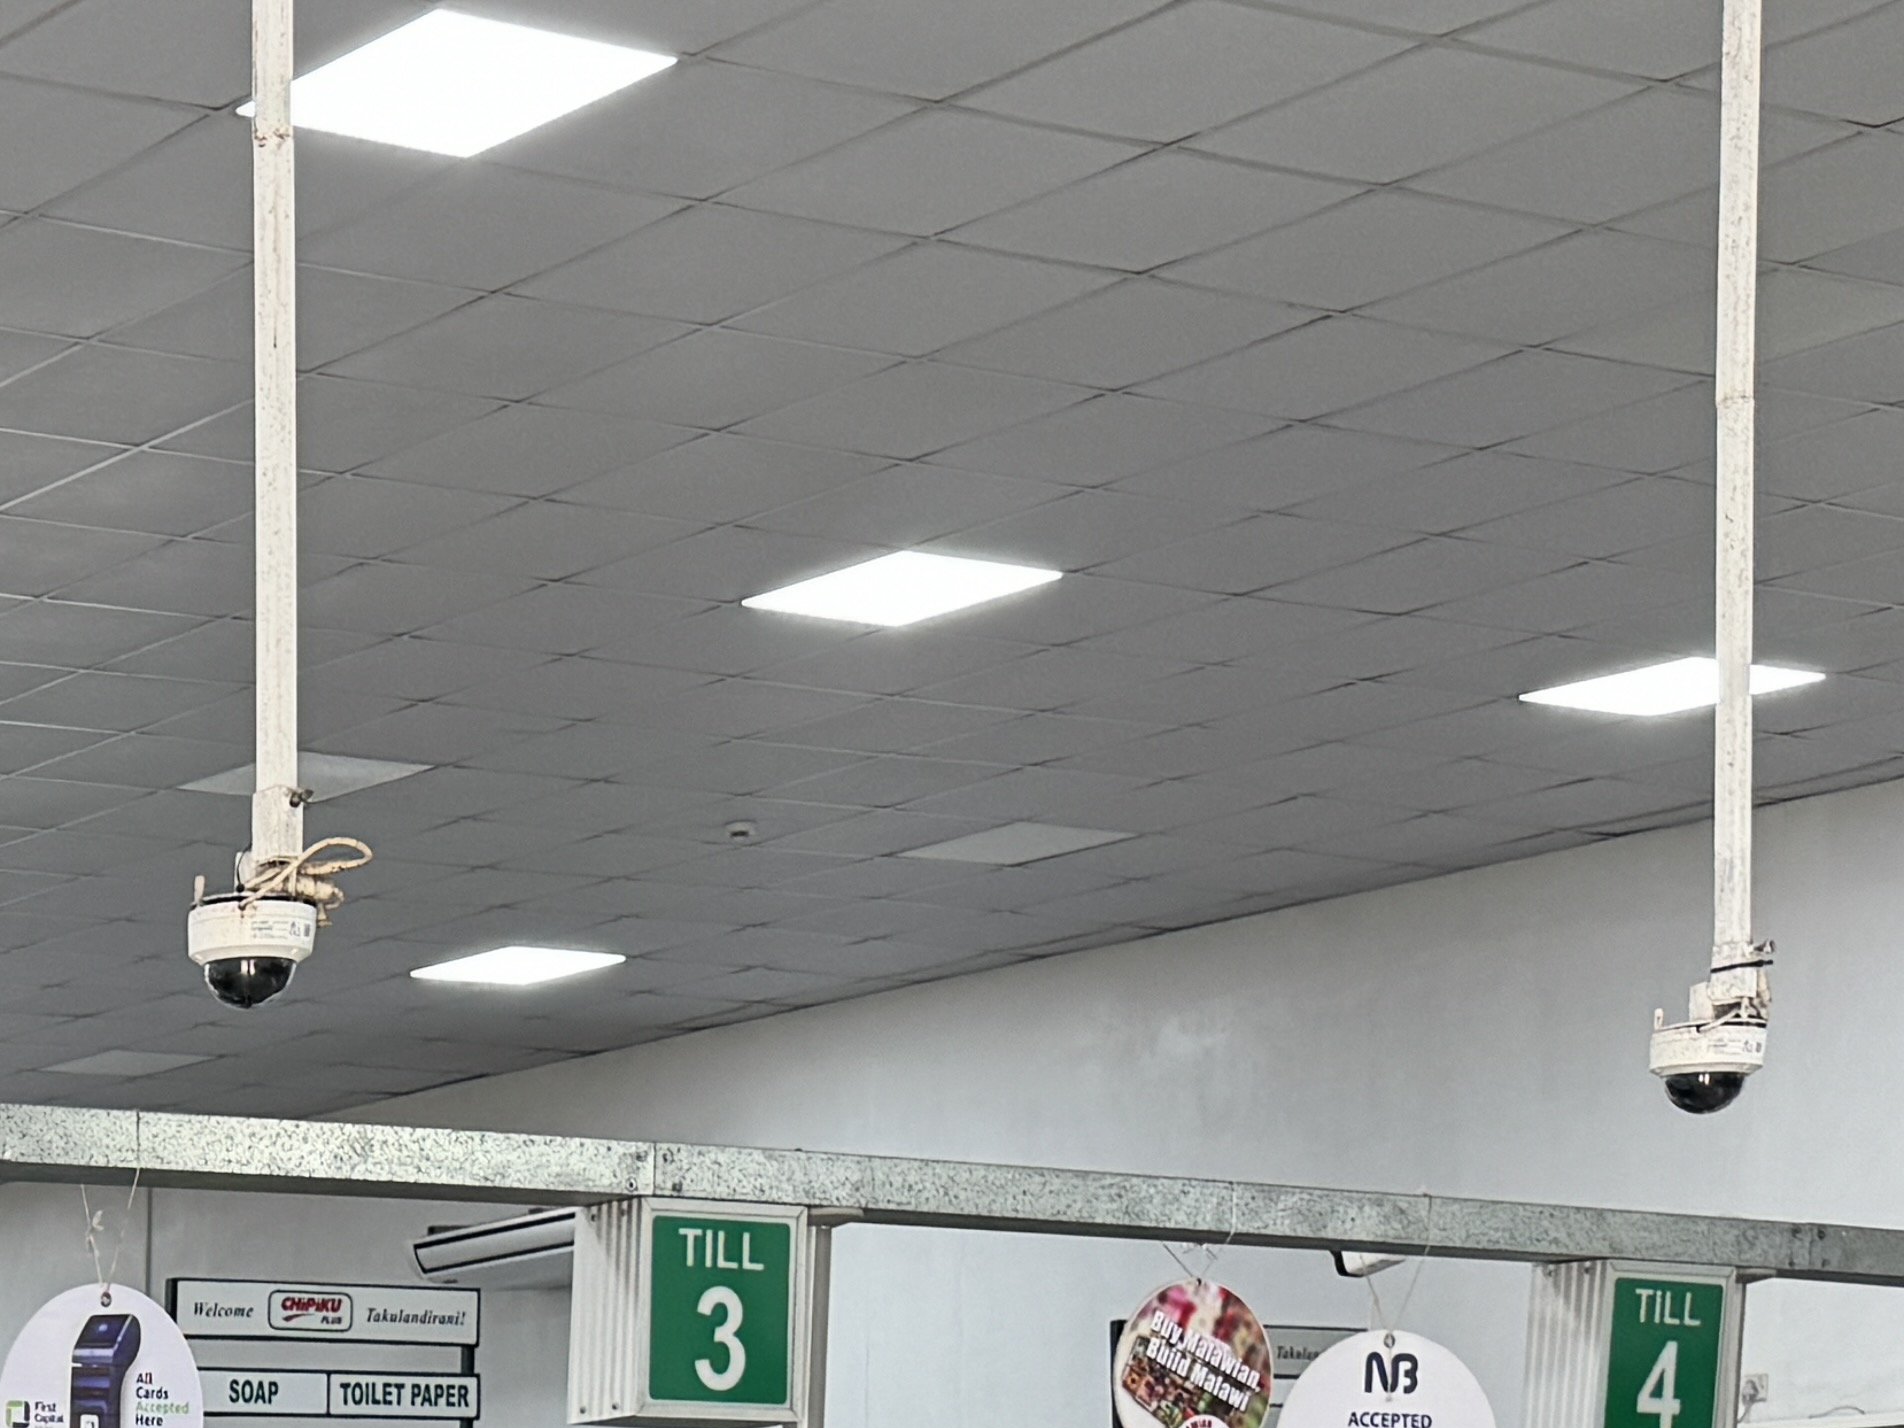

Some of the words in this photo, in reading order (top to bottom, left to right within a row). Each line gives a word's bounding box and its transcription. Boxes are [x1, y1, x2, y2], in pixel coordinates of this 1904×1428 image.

[678, 1228, 765, 1271] TILL
[194, 1302, 254, 1318] Welcome
[1635, 1288, 1701, 1328] TILL
[321, 1316, 342, 1324] PLUS
[366, 1308, 466, 1326] Takulandirani!
[694, 1286, 747, 1391] 3
[1150, 1310, 1182, 1347] Buy
[1183, 1328, 1262, 1393] Malawian,
[136, 1372, 153, 1385] All
[1146, 1338, 1189, 1377] Build
[1190, 1361, 1251, 1413] Malawi
[136, 1387, 169, 1400] Cards
[229, 1380, 279, 1404] SOAP
[340, 1382, 405, 1406] TOILET
[411, 1384, 469, 1408] PAPER
[35, 1401, 57, 1412] First
[135, 1402, 189, 1414] Accepted
[34, 1413, 64, 1424] Capital
[135, 1414, 163, 1427] Here
[1348, 1412, 1432, 1428] ACCEPTED
